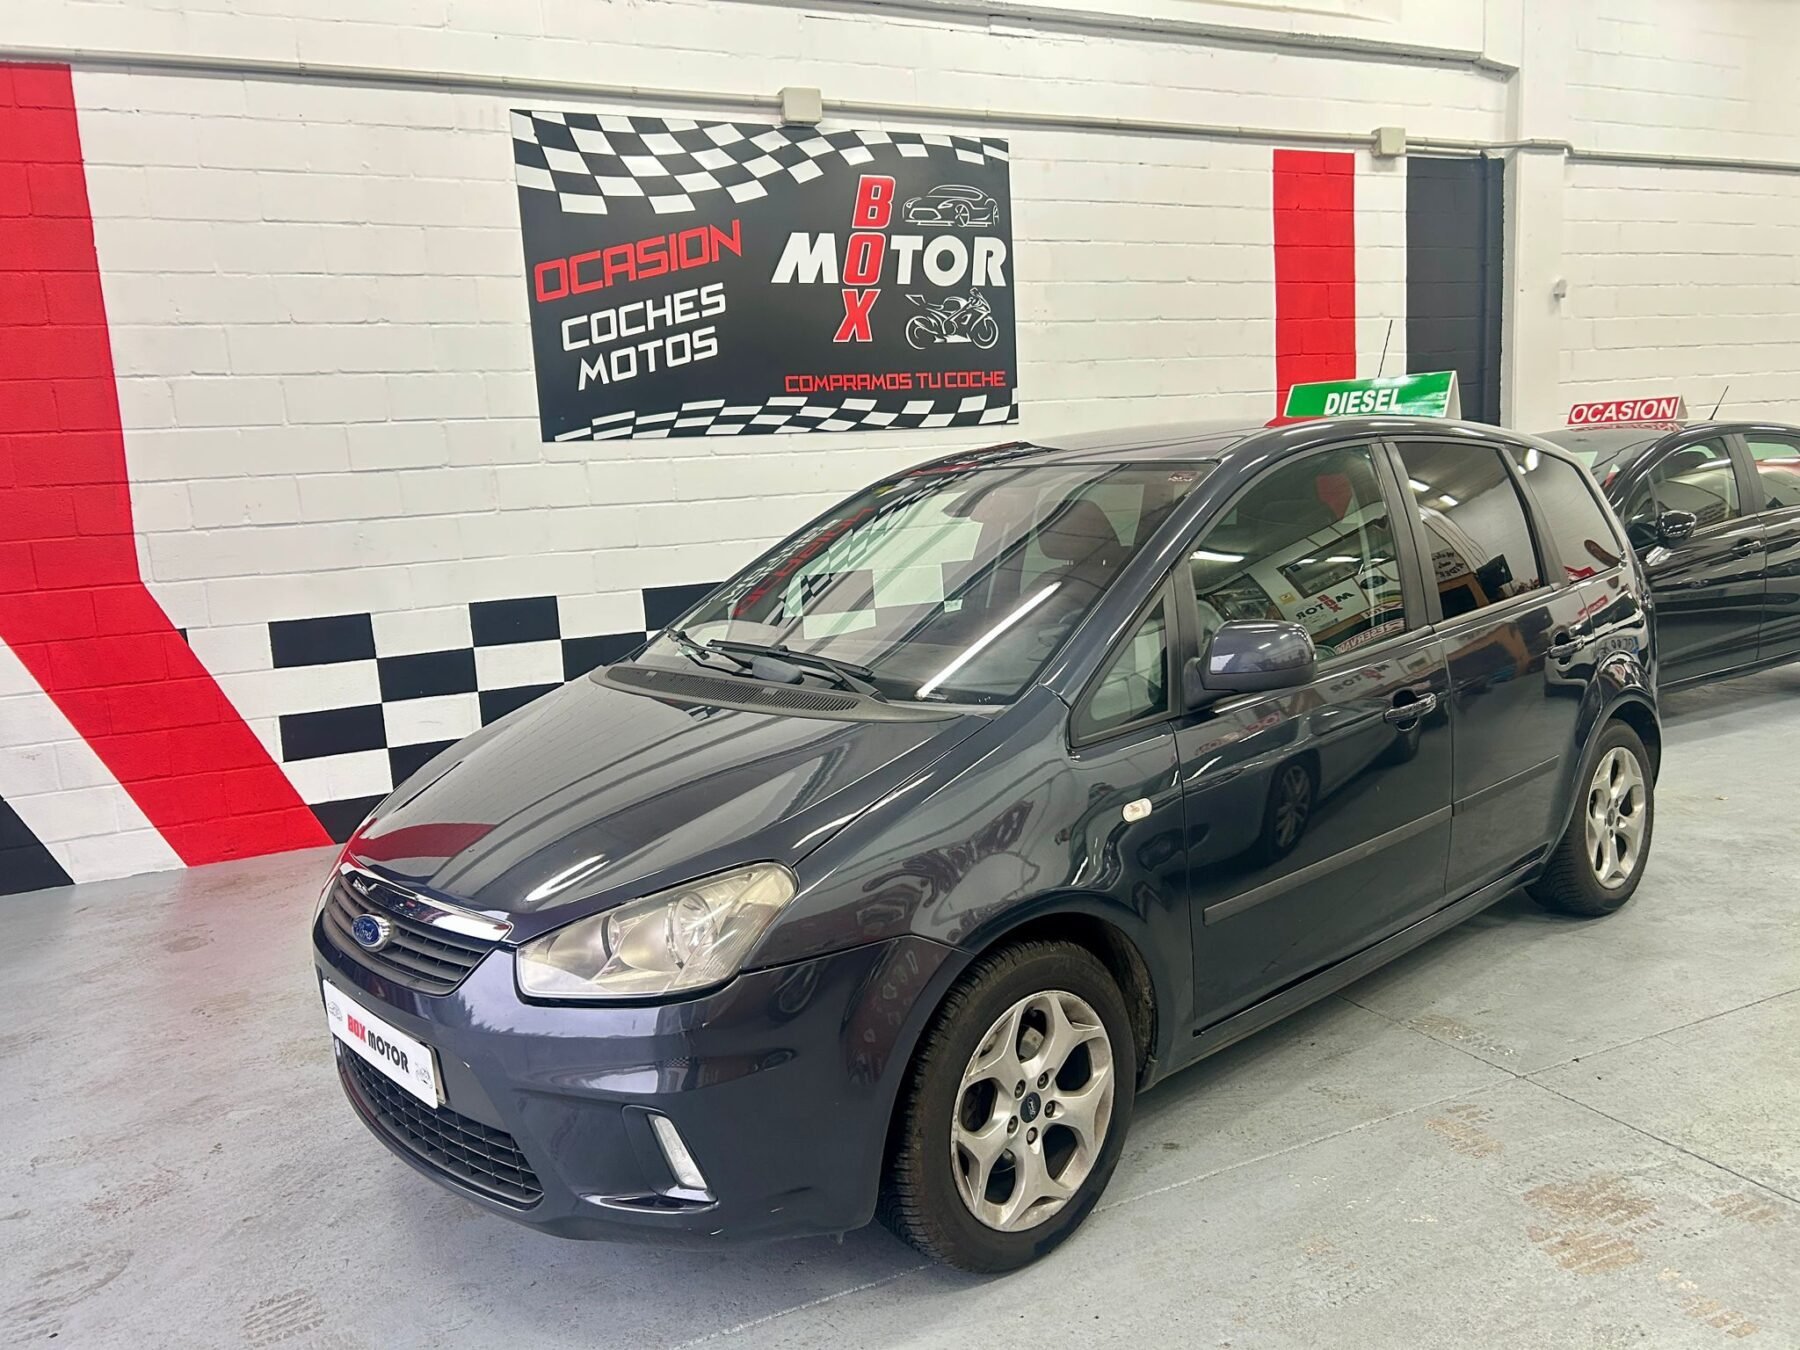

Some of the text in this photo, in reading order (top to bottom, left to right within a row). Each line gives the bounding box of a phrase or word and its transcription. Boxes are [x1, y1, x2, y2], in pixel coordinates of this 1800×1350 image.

[533, 218, 743, 304] OCASION
[770, 231, 1007, 288] MOTOR
[833, 174, 896, 343] BOX
[561, 281, 727, 352] COCHES
[578, 325, 719, 391] MOTOS
[784, 370, 1006, 393] COMPRAMOS TU COCHE
[1324, 388, 1402, 416] DIESEL
[1570, 398, 1677, 423] OCASION
[347, 1013, 410, 1074] BOX MOTOR
